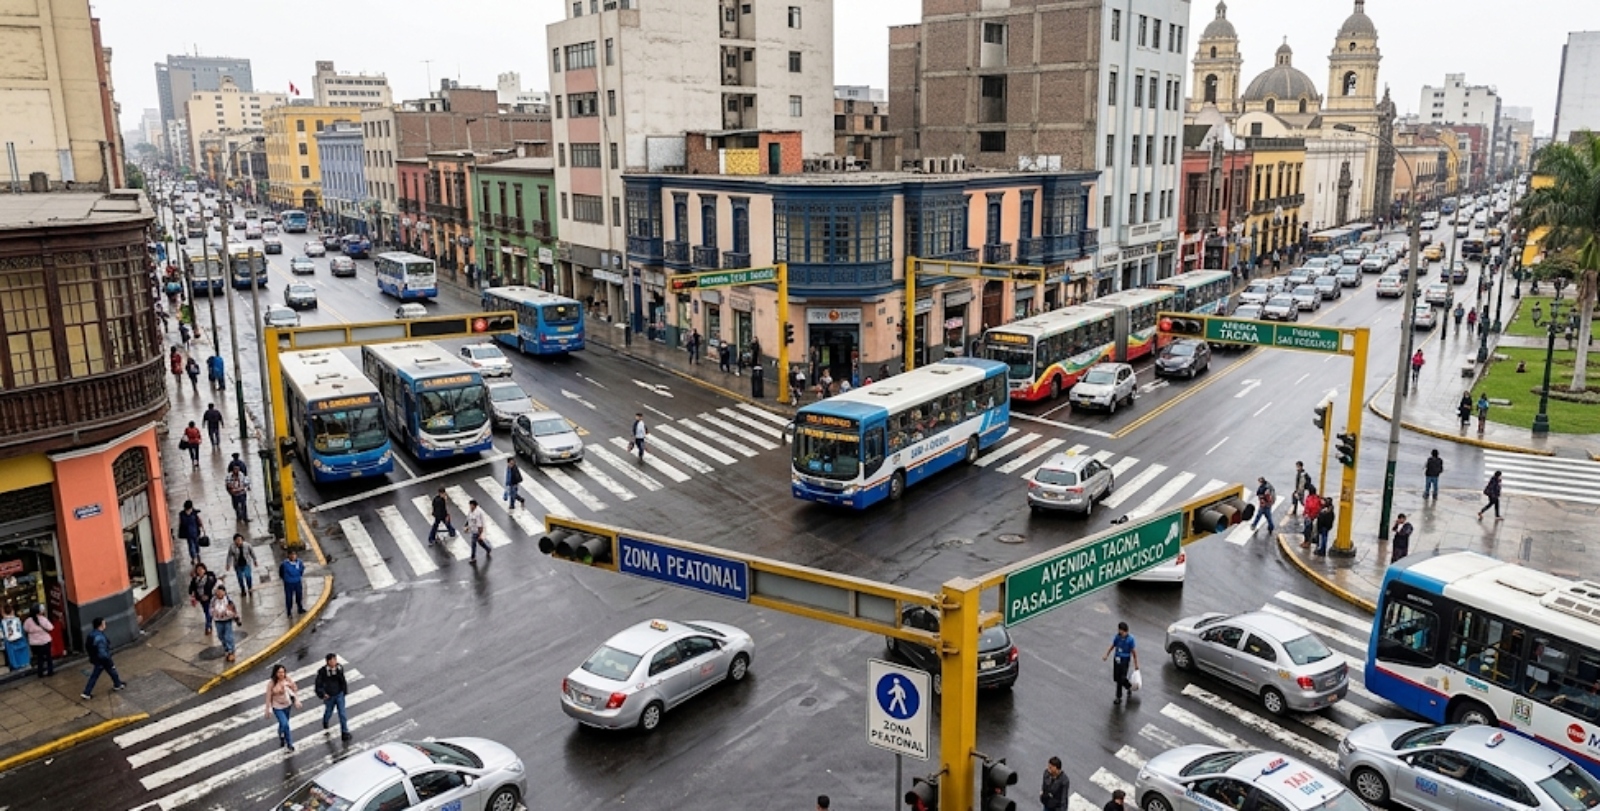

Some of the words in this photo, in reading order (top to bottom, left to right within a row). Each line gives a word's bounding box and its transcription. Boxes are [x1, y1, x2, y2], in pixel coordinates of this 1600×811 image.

[623, 545, 661, 573] ZONA
[667, 554, 742, 591] PEATONAL
[1011, 584, 1063, 618] PASAJE
[1069, 571, 1094, 594] SAN
[1098, 544, 1164, 582] FRANCISCO
[1041, 548, 1097, 585] AVENIDA
[1102, 532, 1140, 561] TACNA
[872, 729, 924, 752] PEATONAL
[883, 720, 912, 737] ZONA
